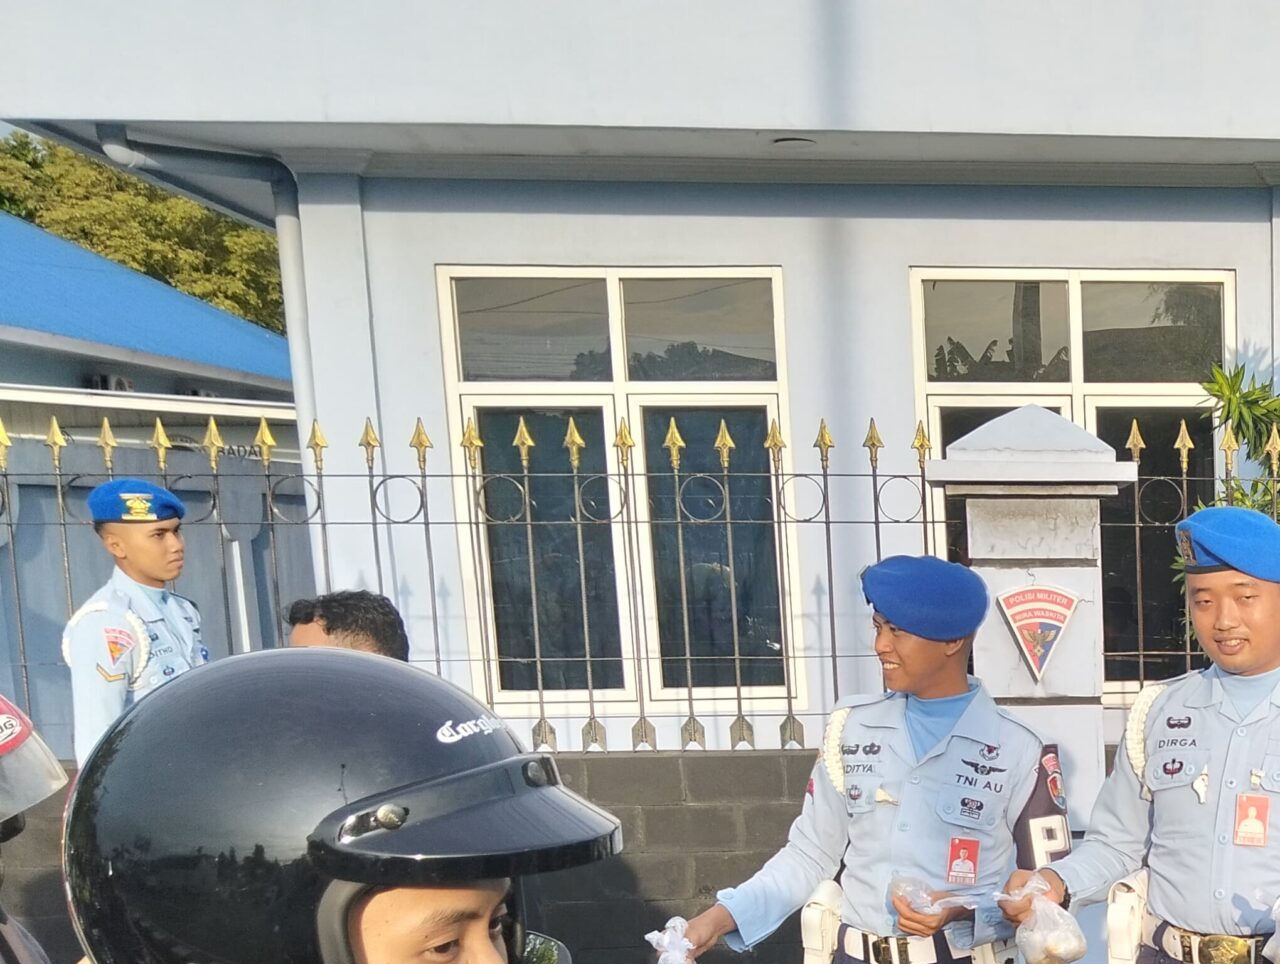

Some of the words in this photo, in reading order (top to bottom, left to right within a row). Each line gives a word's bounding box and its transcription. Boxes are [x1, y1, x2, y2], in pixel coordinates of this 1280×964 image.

[1008, 592, 1035, 604] POLISI
[1037, 592, 1068, 605] MILITER
[1158, 738, 1197, 748] DIRGA
[843, 764, 873, 774] DITYA
[955, 774, 977, 787] TNI
[984, 781, 1004, 793] AU
